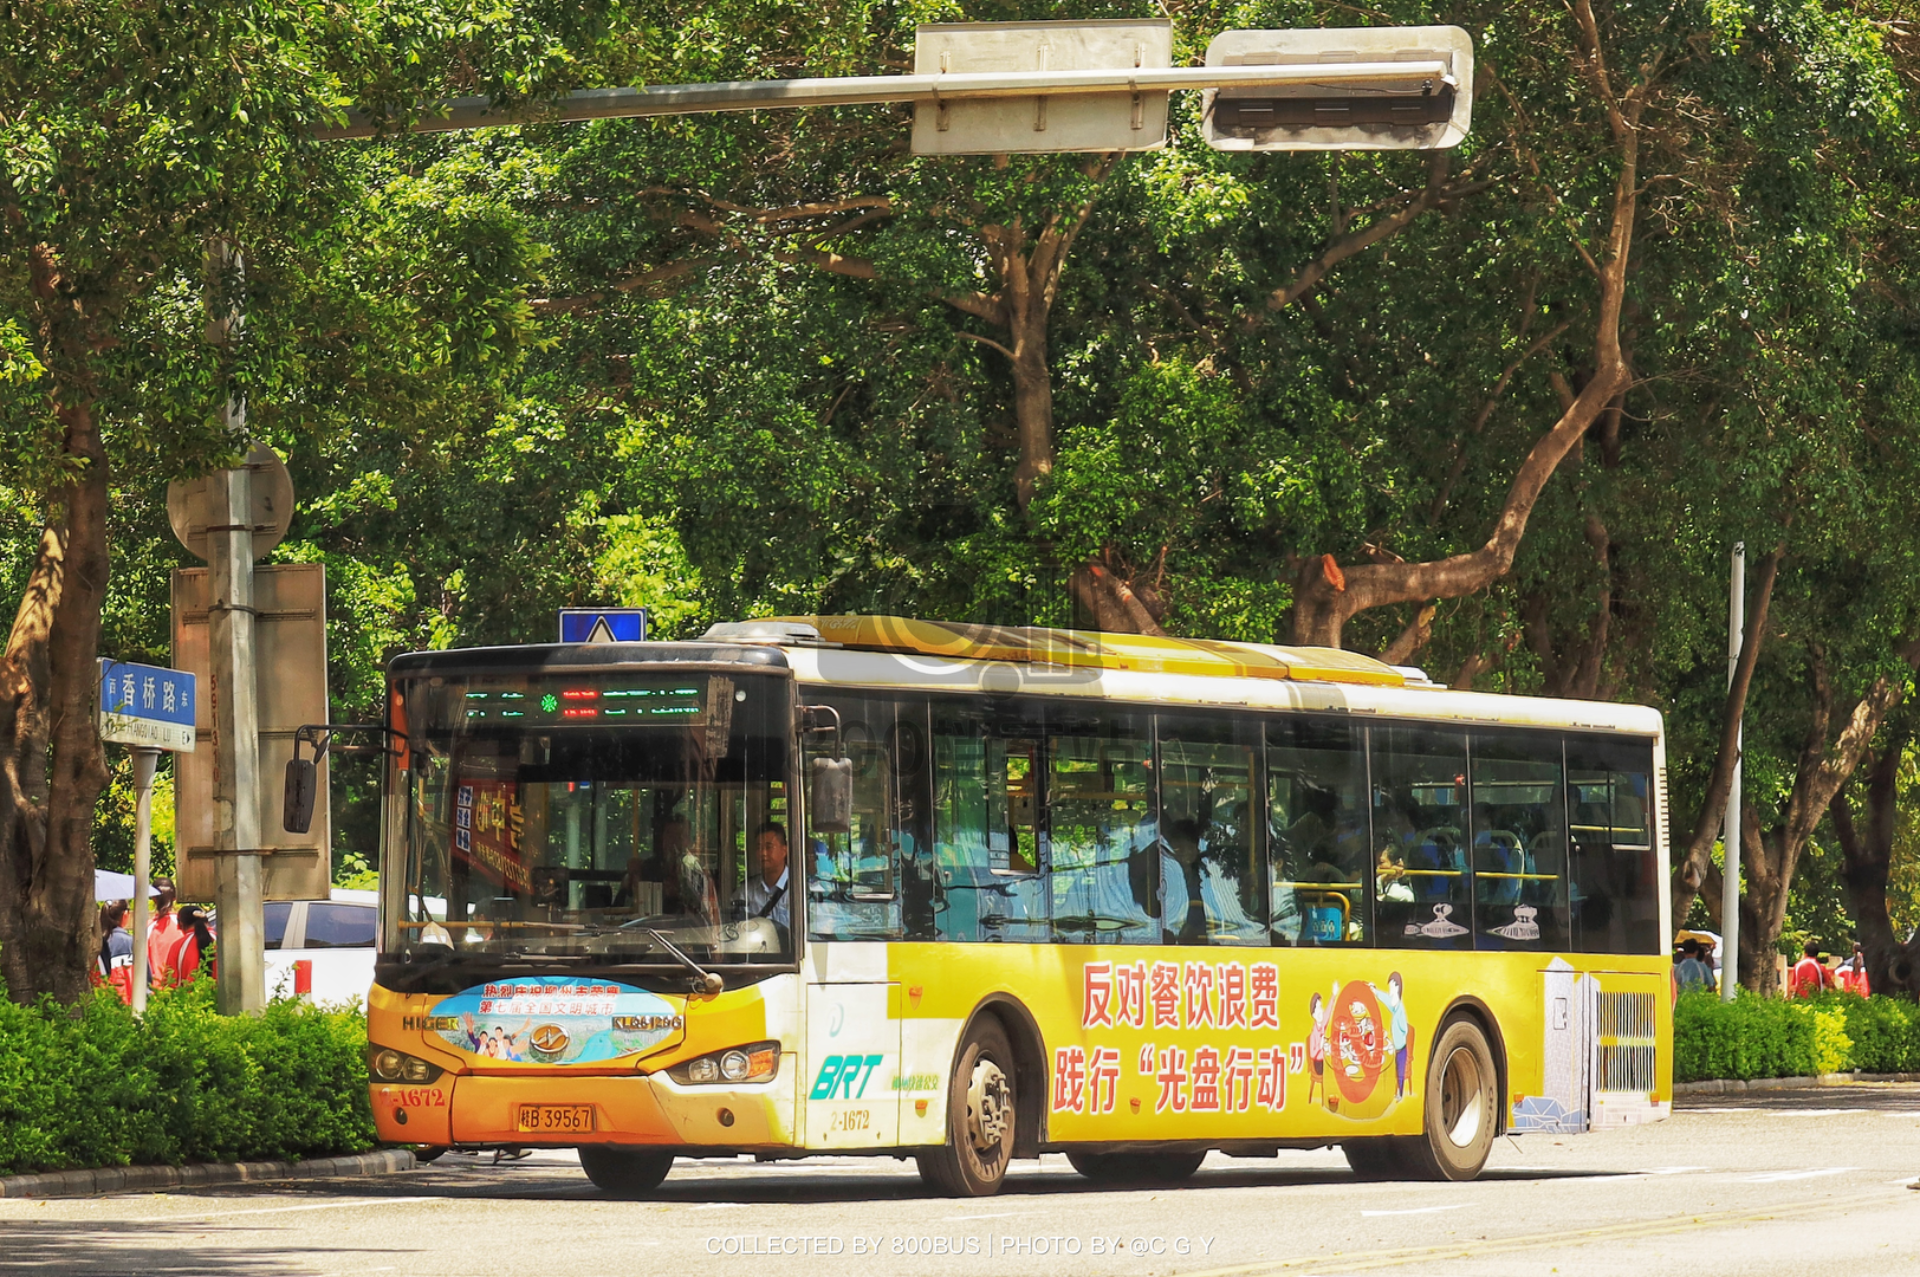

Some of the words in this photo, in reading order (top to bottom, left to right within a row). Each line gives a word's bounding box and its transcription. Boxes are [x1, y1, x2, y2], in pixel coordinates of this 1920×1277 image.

[122, 673, 175, 713] 香桥路
[479, 1000, 615, 1016] 第七届全国文明城市
[1082, 963, 1280, 1028] 反对餐饮浪费
[403, 1016, 460, 1031] HIGER
[809, 1054, 884, 1100] BRT
[830, 1109, 870, 1132] 2-1672
